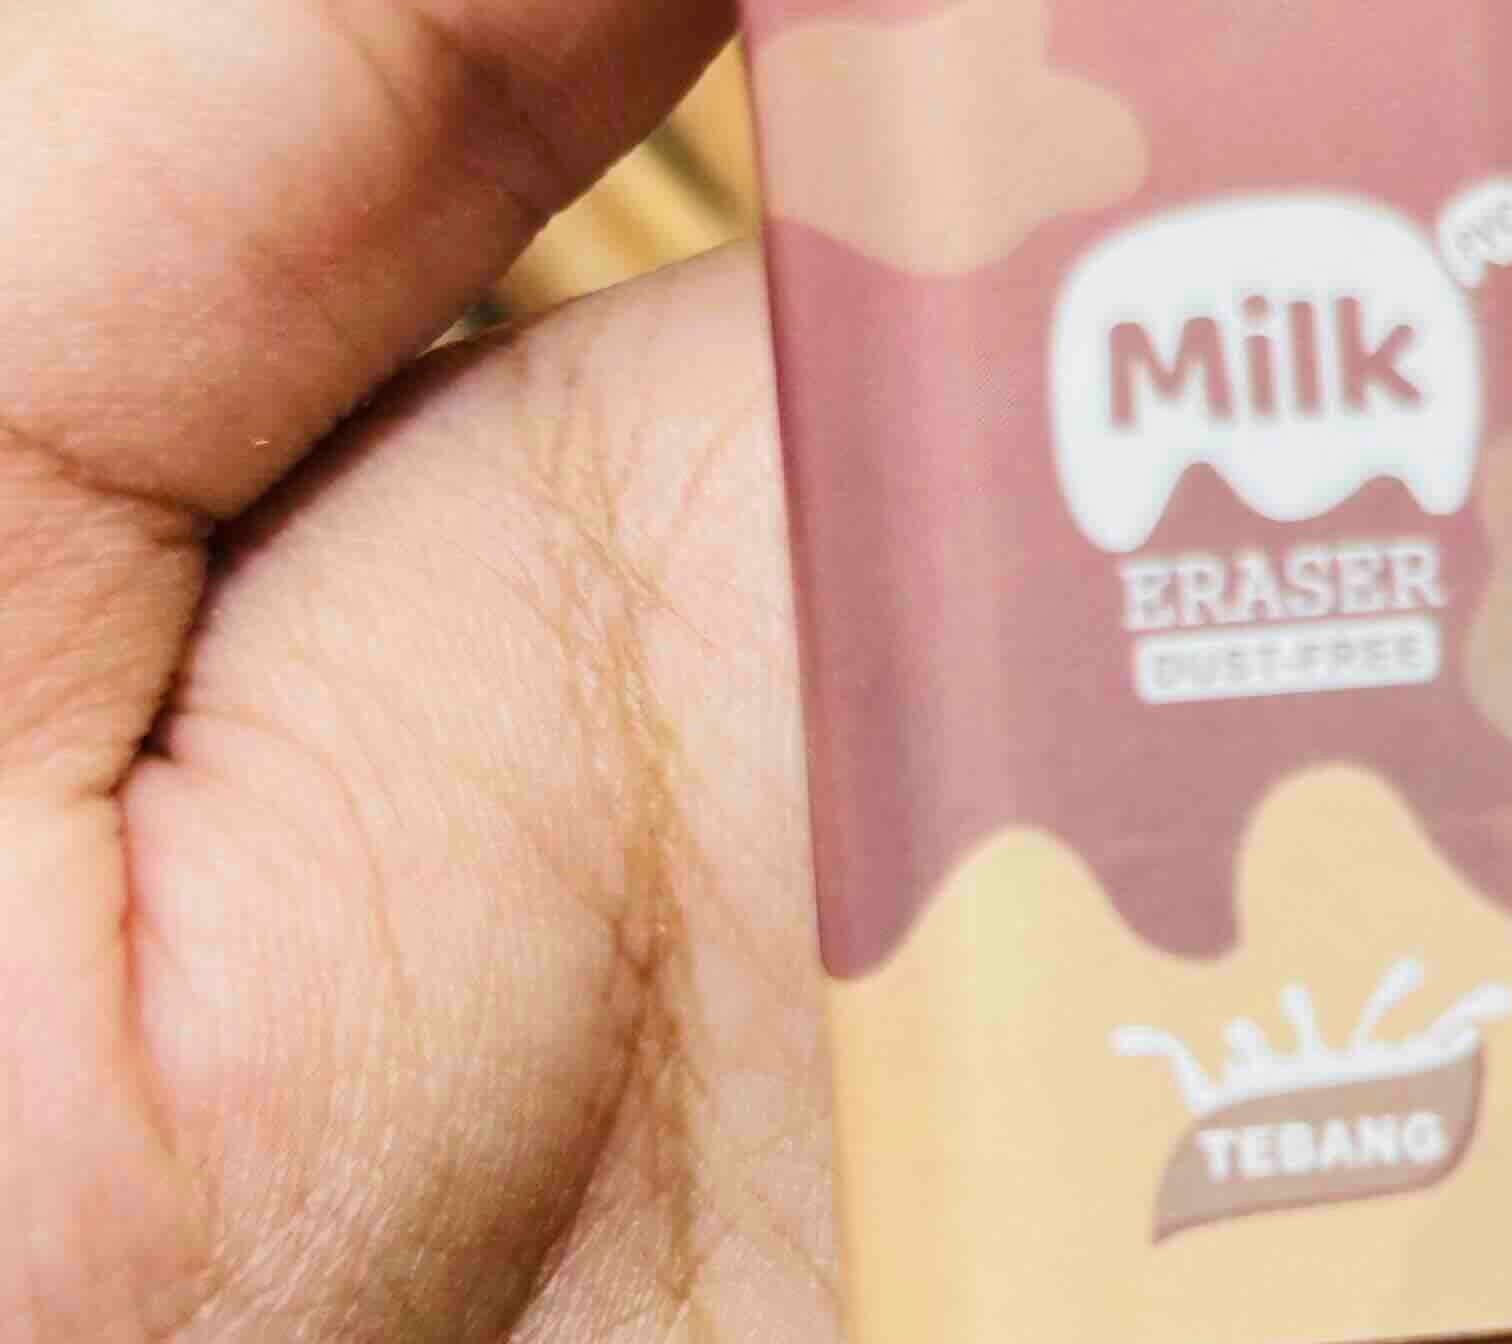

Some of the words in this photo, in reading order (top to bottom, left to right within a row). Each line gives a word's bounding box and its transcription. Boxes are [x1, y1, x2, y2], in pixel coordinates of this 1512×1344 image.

[1107, 293, 1424, 428] Milk
[1119, 540, 1447, 632] ERASER
[1198, 1110, 1448, 1183] TEBANG
